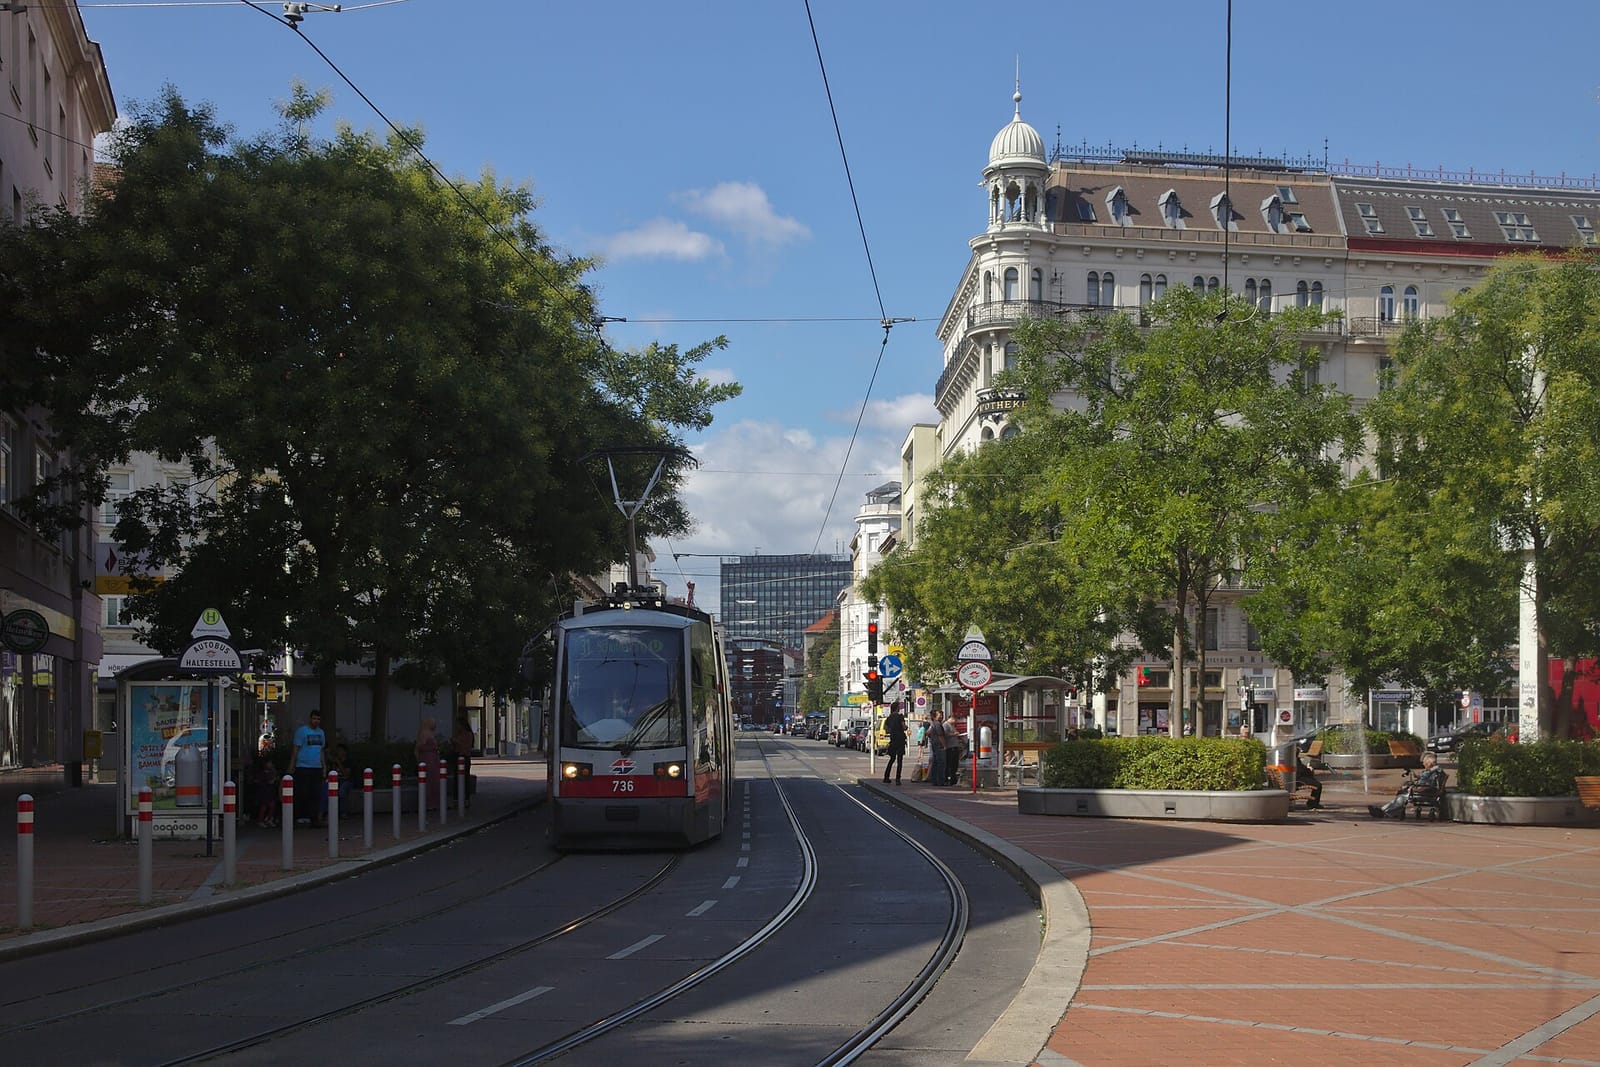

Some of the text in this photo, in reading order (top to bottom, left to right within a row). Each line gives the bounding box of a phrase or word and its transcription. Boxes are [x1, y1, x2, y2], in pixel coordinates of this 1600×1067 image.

[979, 400, 1027, 411] POTHEKE
[193, 641, 231, 654] AUTOBUS
[186, 659, 236, 667] HALTESTELLE
[612, 780, 634, 792] 736
